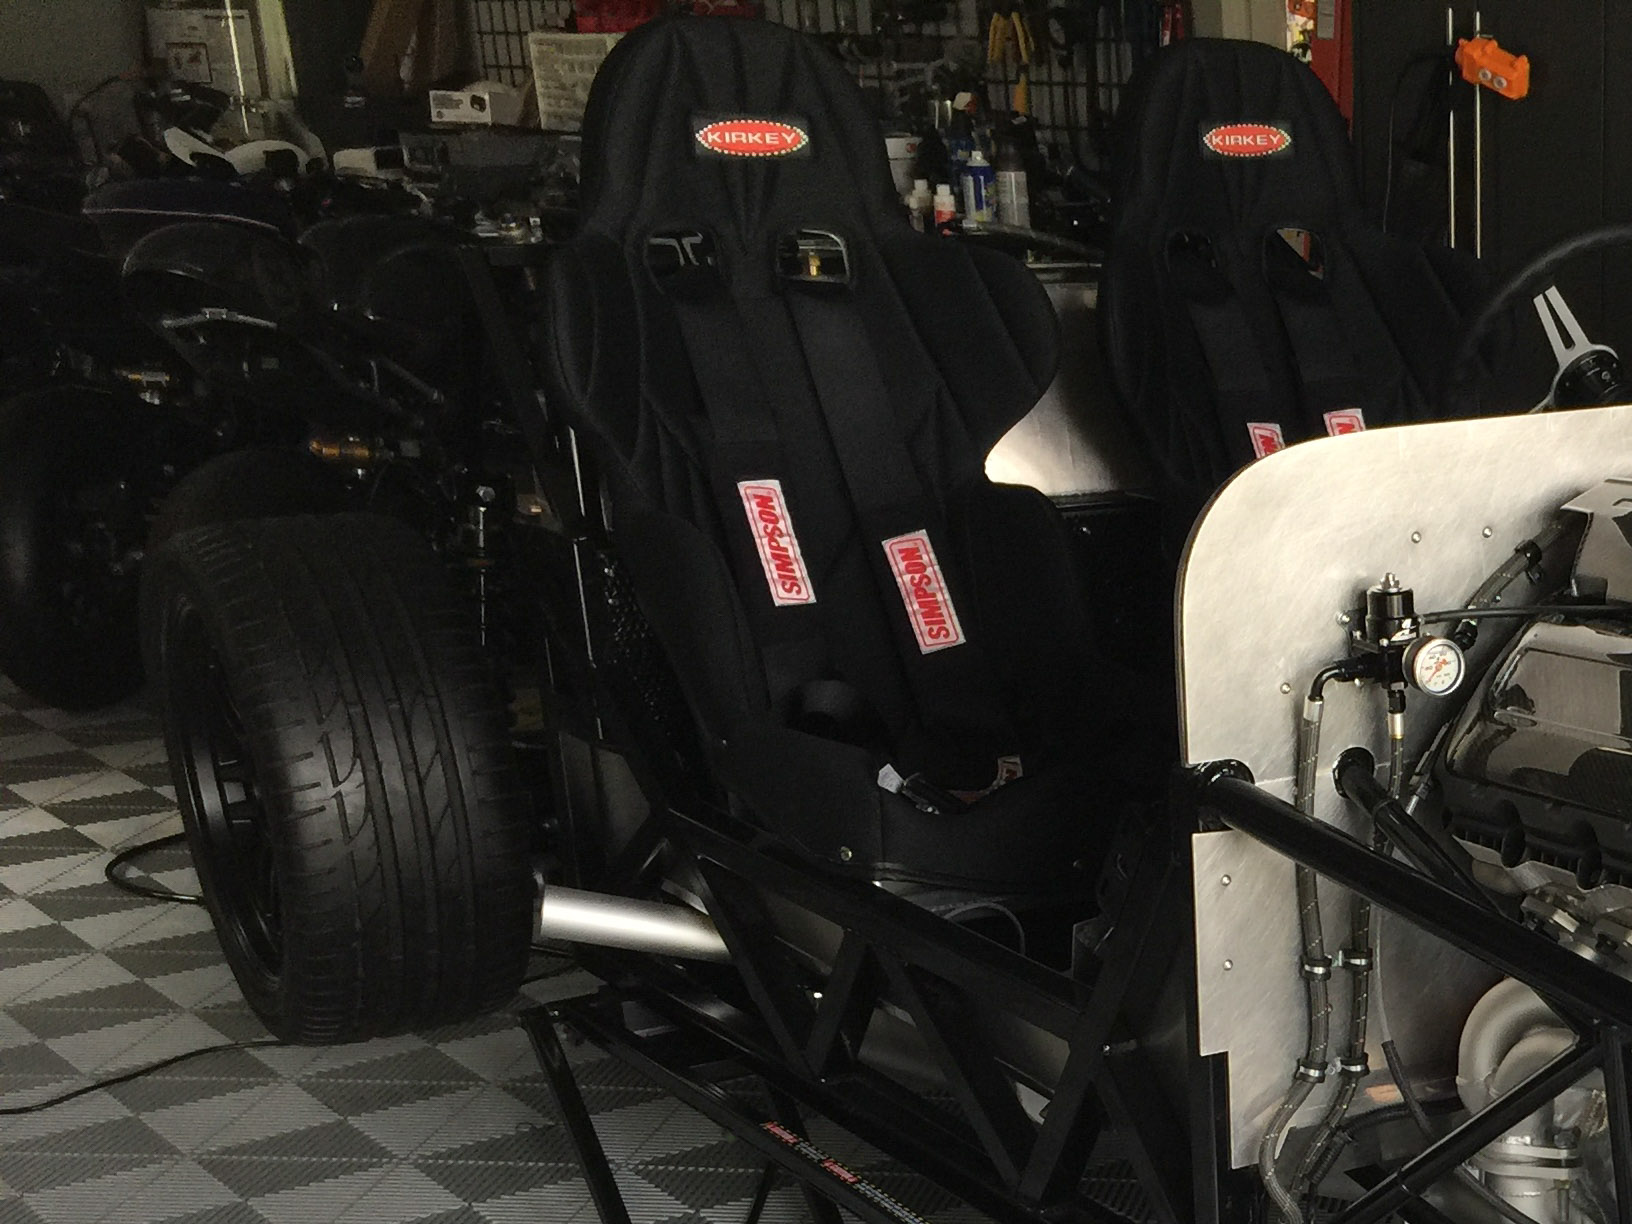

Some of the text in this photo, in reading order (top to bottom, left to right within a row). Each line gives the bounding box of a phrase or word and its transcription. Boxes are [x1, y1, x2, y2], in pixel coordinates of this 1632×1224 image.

[708, 131, 796, 145] KIRKEY
[1211, 134, 1281, 146] KIRKEY
[752, 494, 801, 595] SIMPSON
[898, 547, 950, 640] SIMPSON
